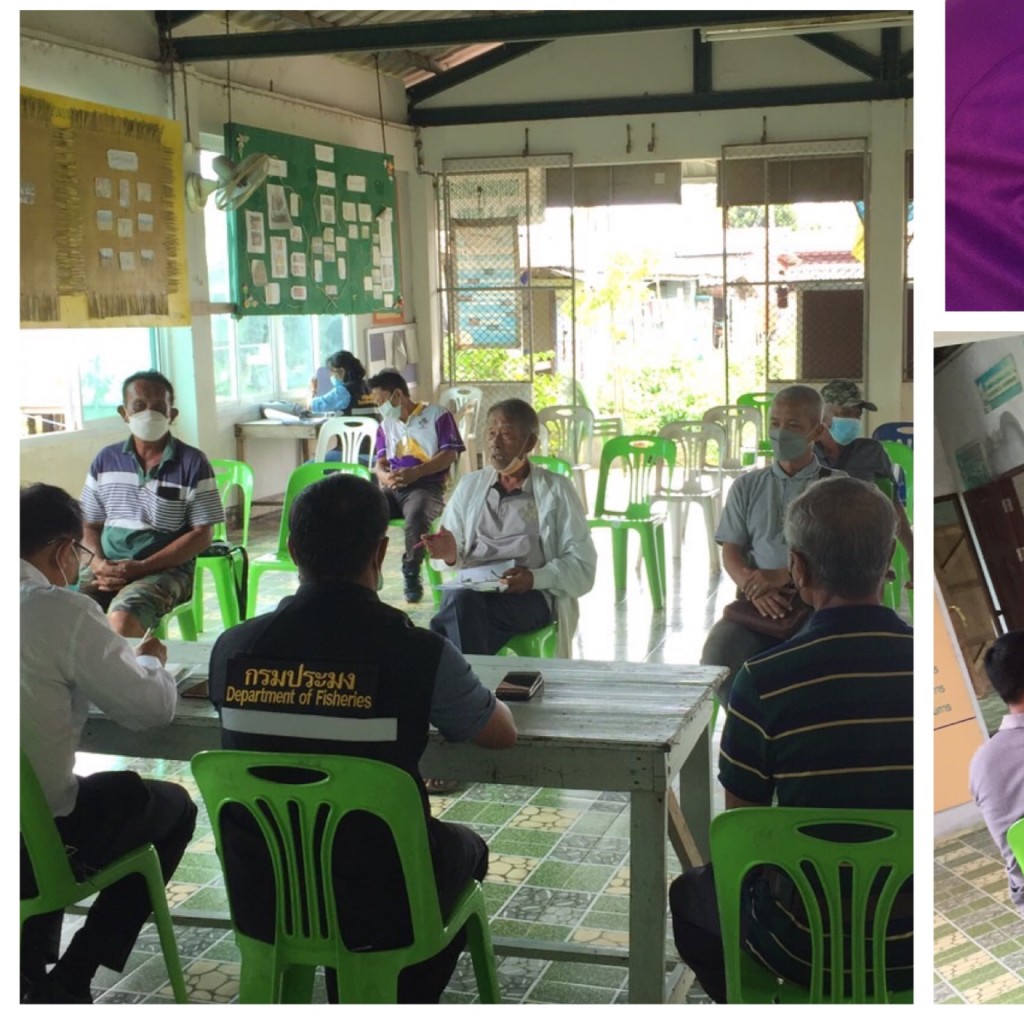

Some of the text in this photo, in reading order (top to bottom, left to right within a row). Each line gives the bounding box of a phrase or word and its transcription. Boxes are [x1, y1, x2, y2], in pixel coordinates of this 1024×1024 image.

[244, 664, 357, 691] กรมประมง
[226, 686, 373, 709] Department of Fisheries
